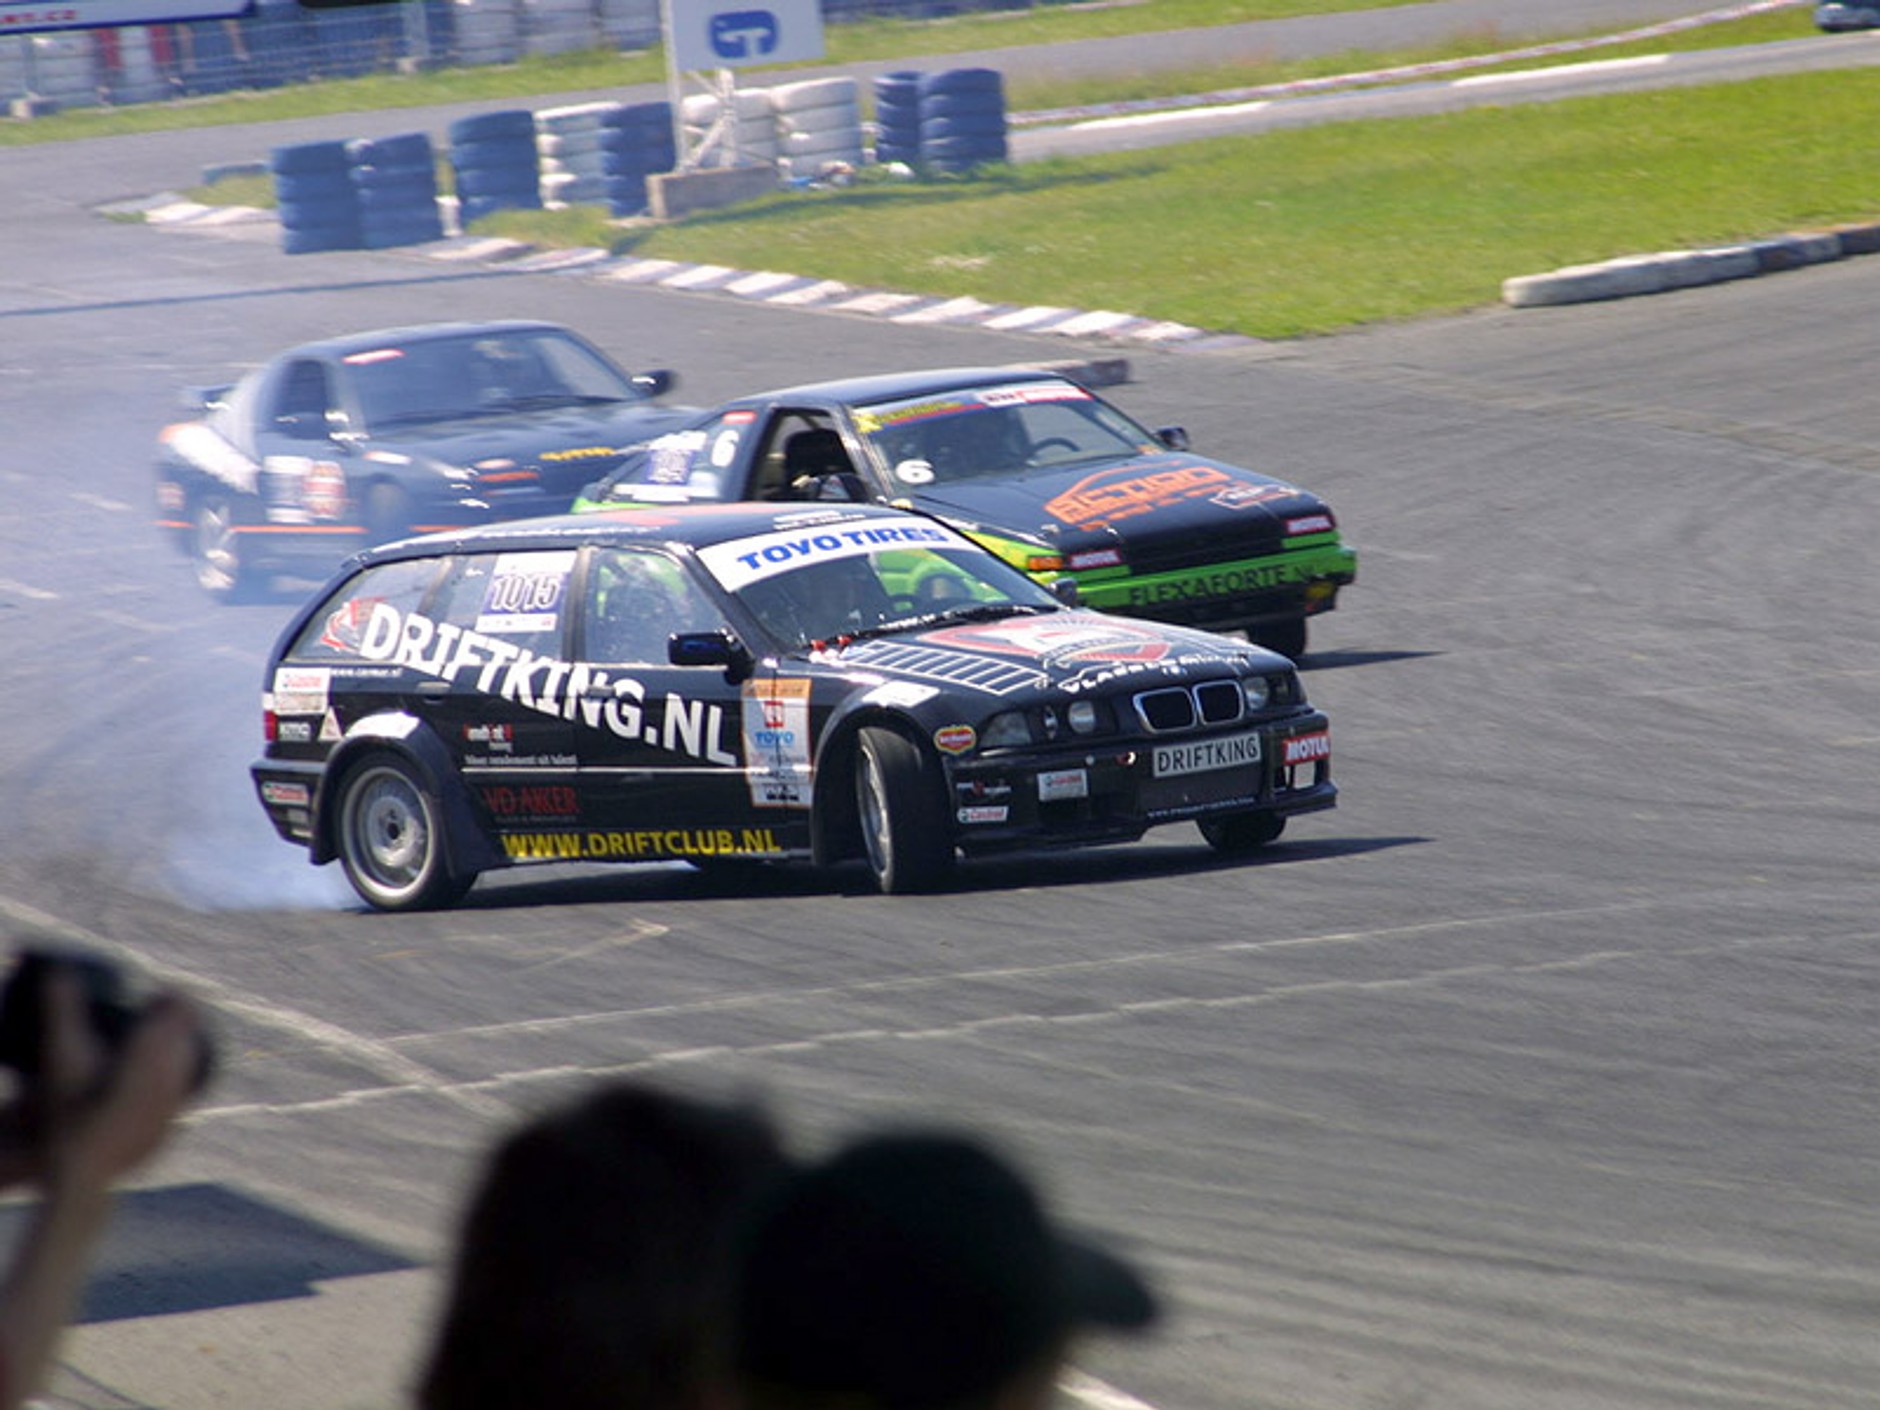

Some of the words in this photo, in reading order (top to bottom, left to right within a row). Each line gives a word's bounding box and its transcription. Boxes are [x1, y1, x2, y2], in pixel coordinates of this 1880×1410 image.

[711, 430, 740, 467] 6
[895, 460, 935, 484] 6
[736, 535, 843, 570] TOYO
[841, 527, 949, 546] TIRES
[490, 574, 560, 613] 1015
[359, 602, 737, 767] DRIFTKING.NL
[755, 731, 794, 746] TOYO
[1157, 737, 1259, 773] DRIFTKING
[500, 828, 782, 858] WWW.DRIFTCLUB.NL
